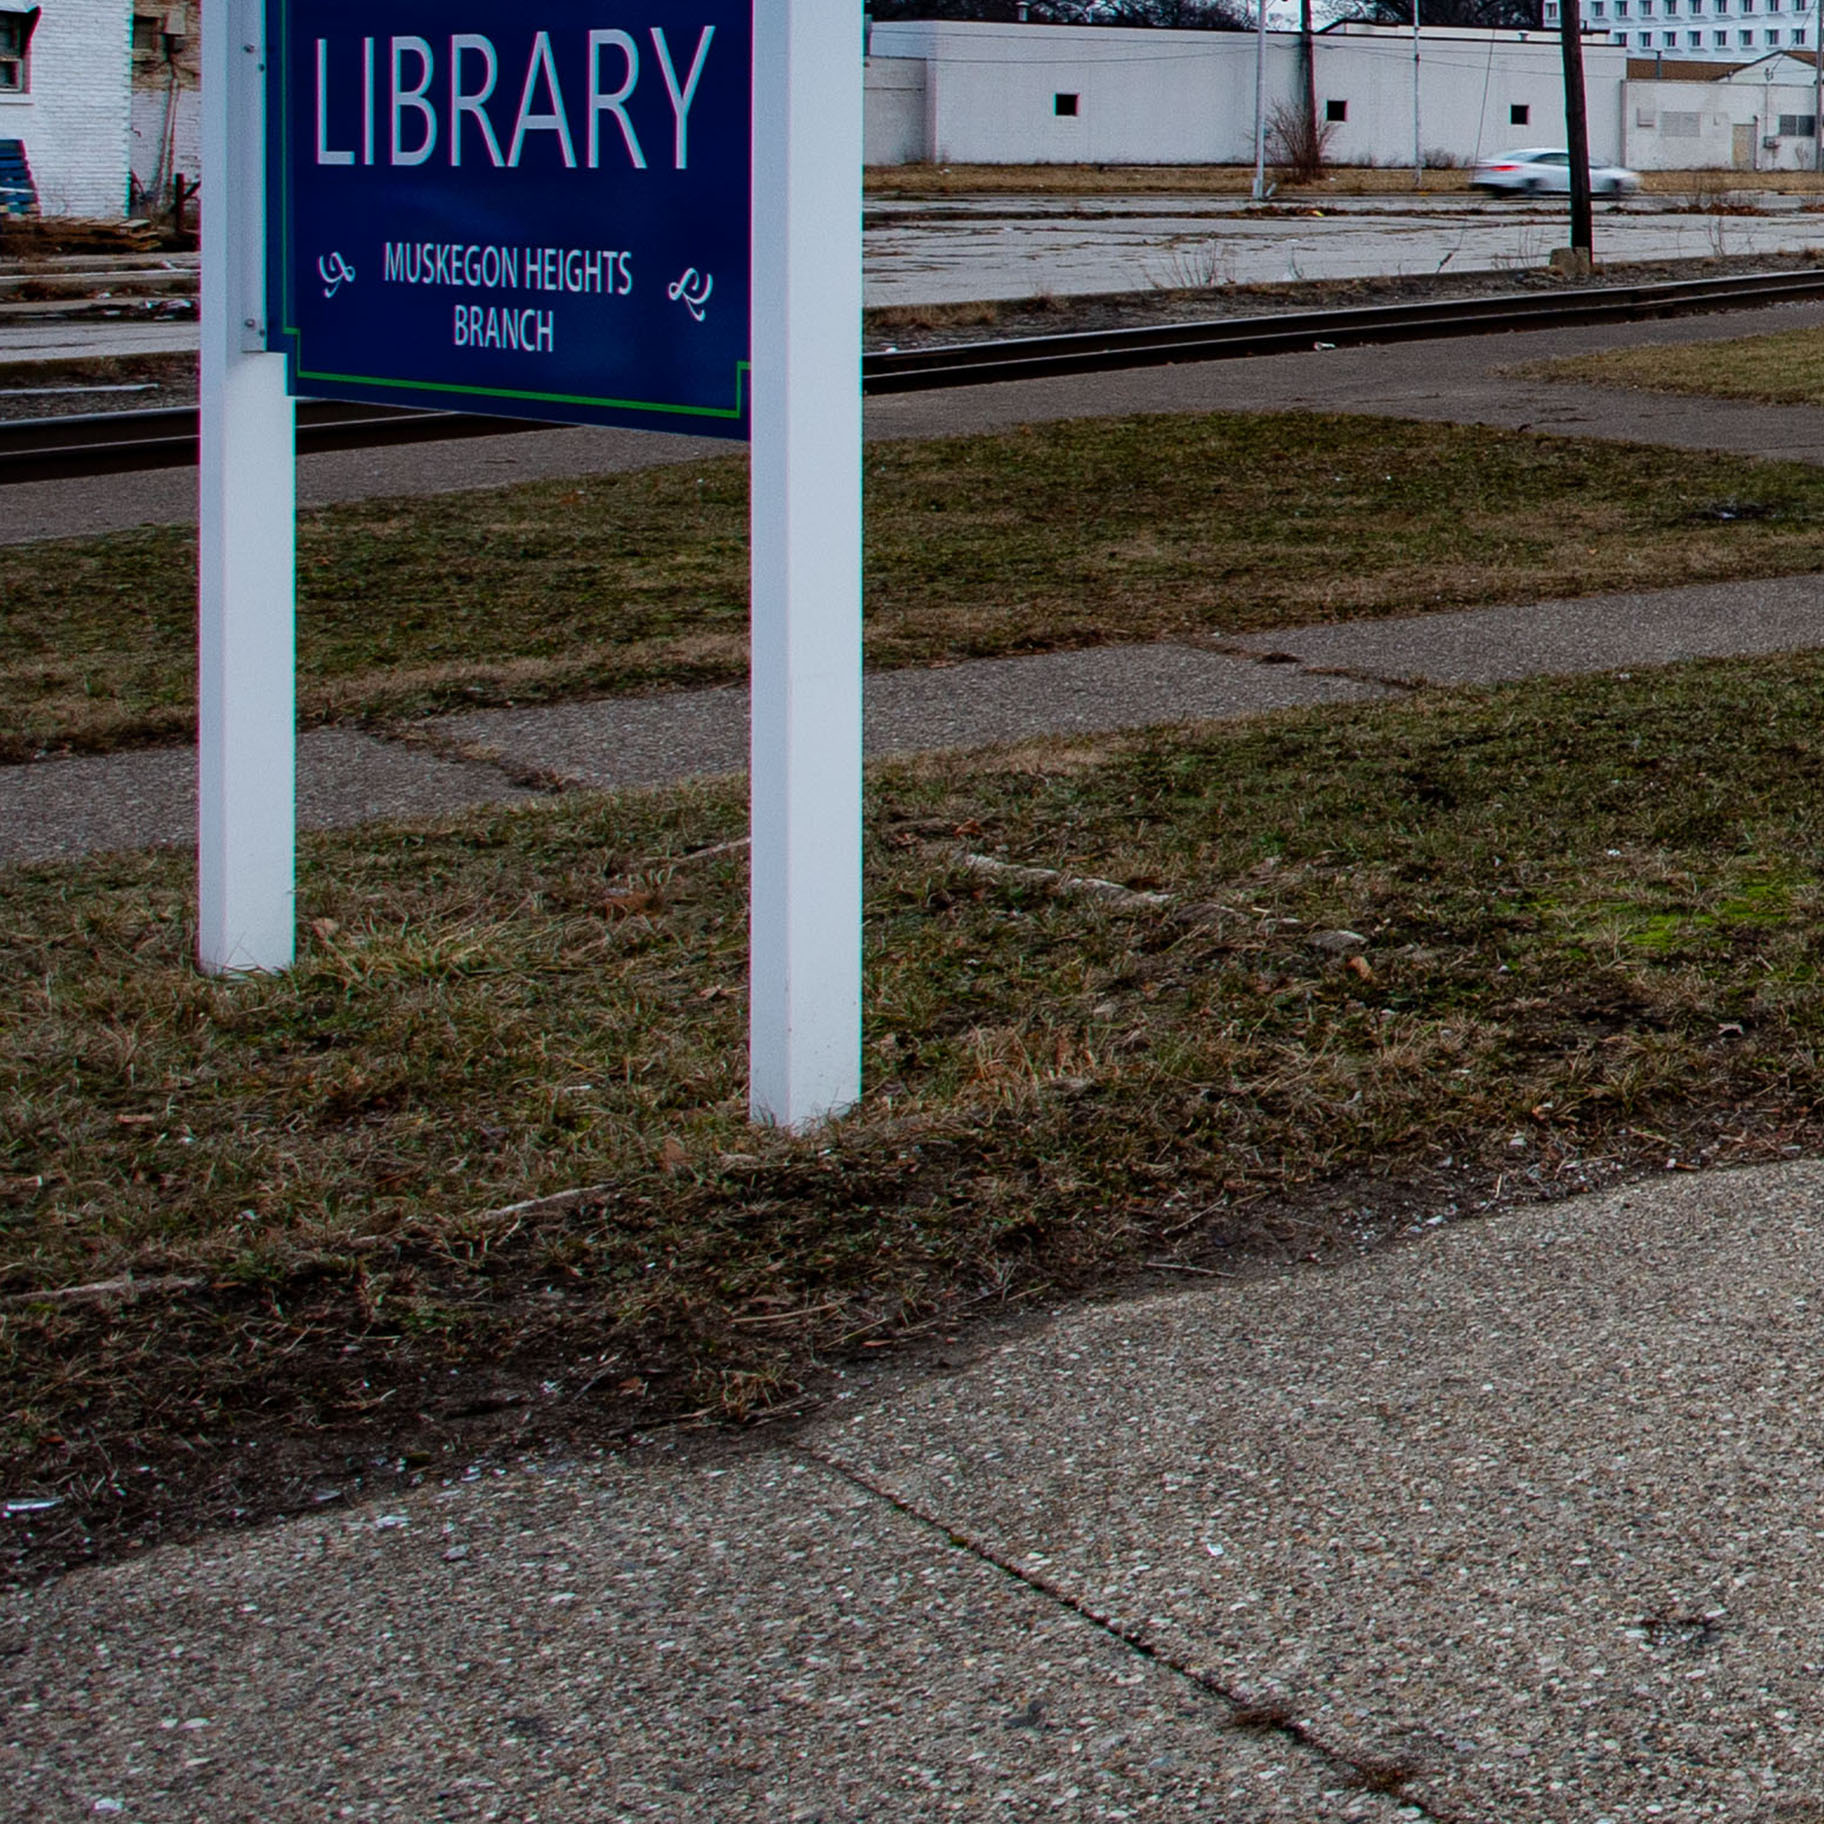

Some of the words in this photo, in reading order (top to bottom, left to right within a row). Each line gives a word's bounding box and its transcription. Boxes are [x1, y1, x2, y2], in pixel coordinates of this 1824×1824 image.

[315, 25, 717, 171] LIBRARY
[384, 242, 518, 288] MUSKEGON
[525, 247, 633, 295] HEIGHTS
[454, 304, 554, 352] BRANCH
